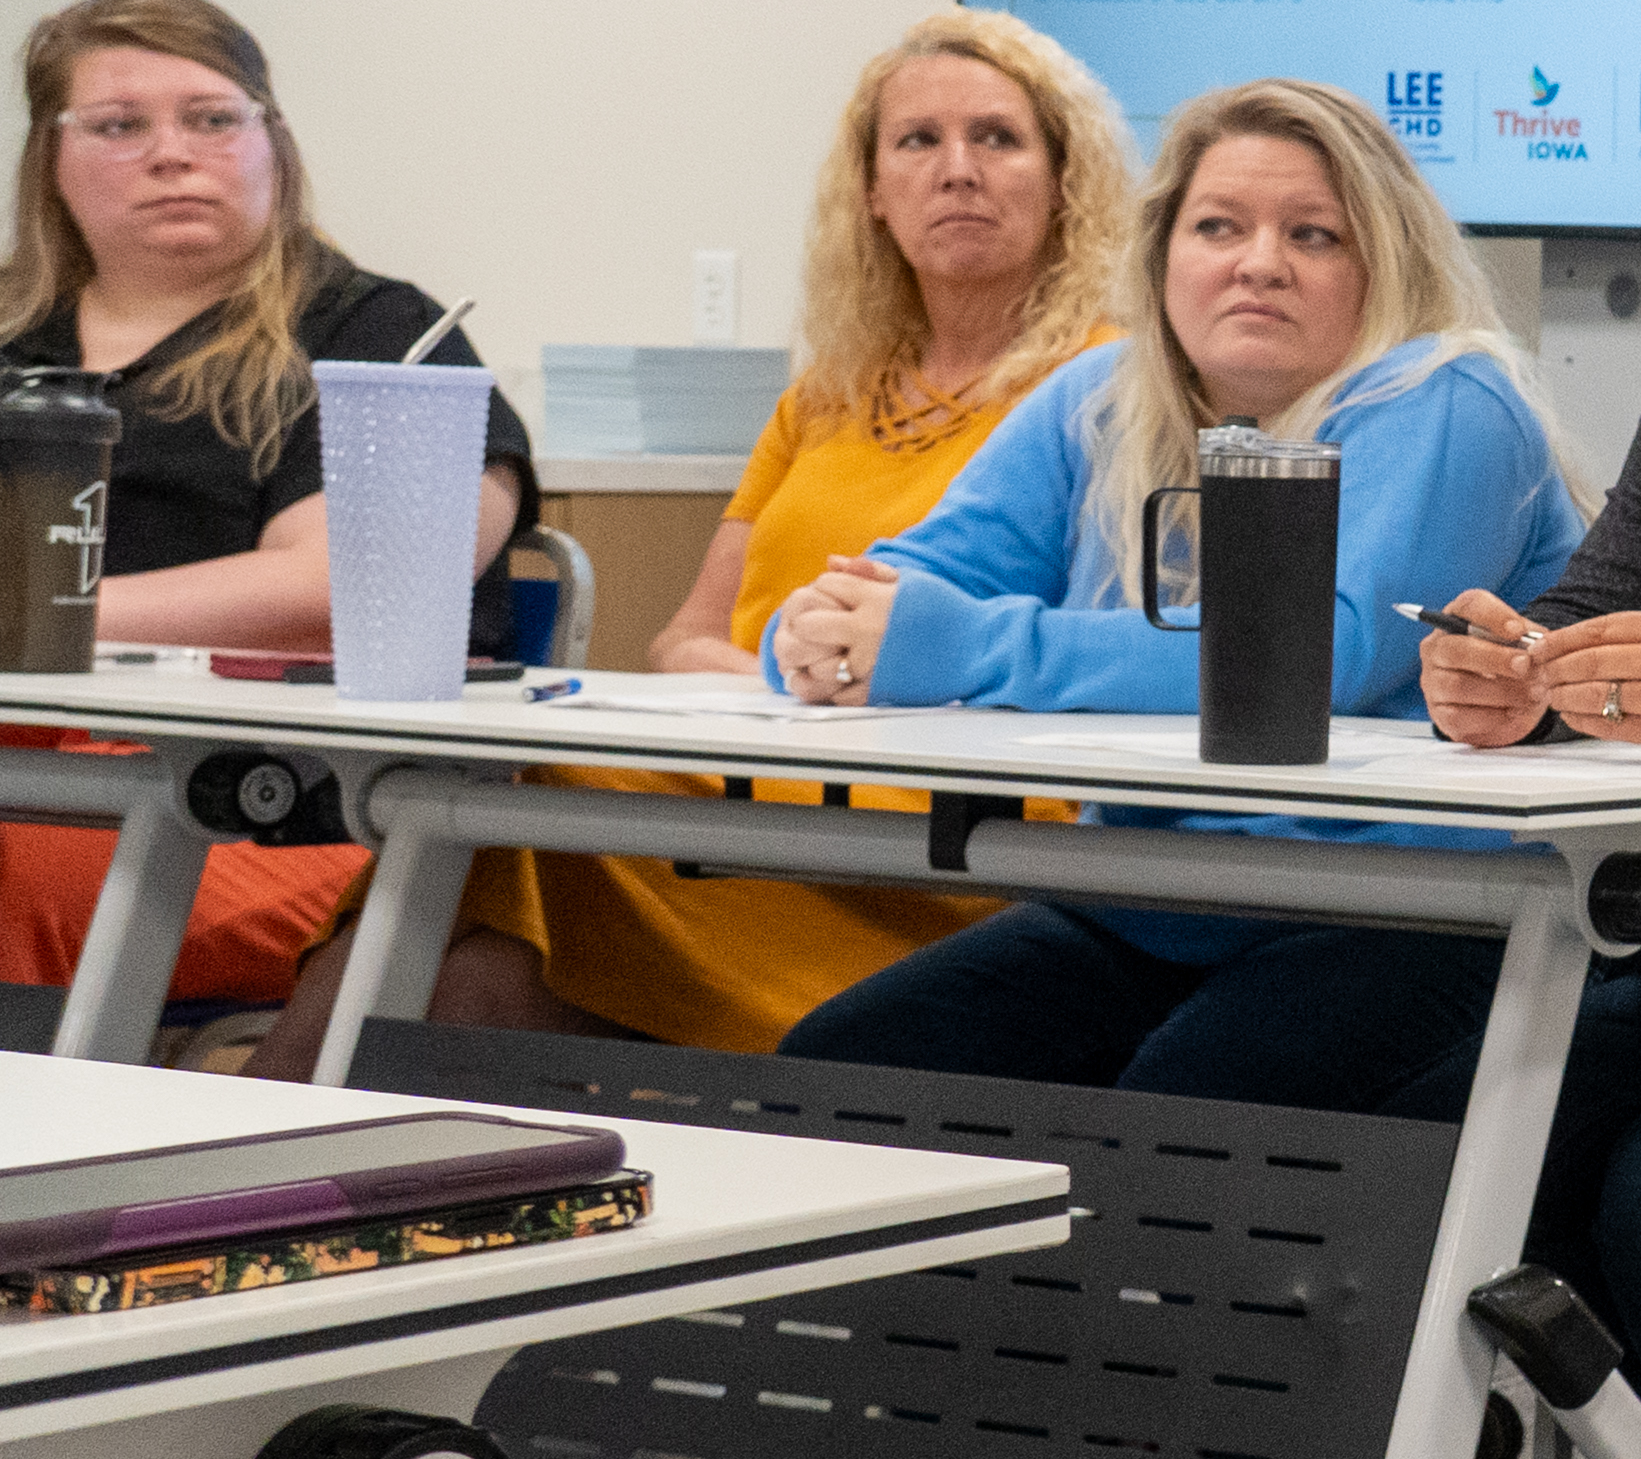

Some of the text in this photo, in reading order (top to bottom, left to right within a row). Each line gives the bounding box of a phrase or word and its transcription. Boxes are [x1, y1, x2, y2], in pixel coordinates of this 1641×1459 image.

[1386, 71, 1443, 107] LEE
[1493, 109, 1582, 138] Thrive
[1527, 142, 1590, 162] IOWA
